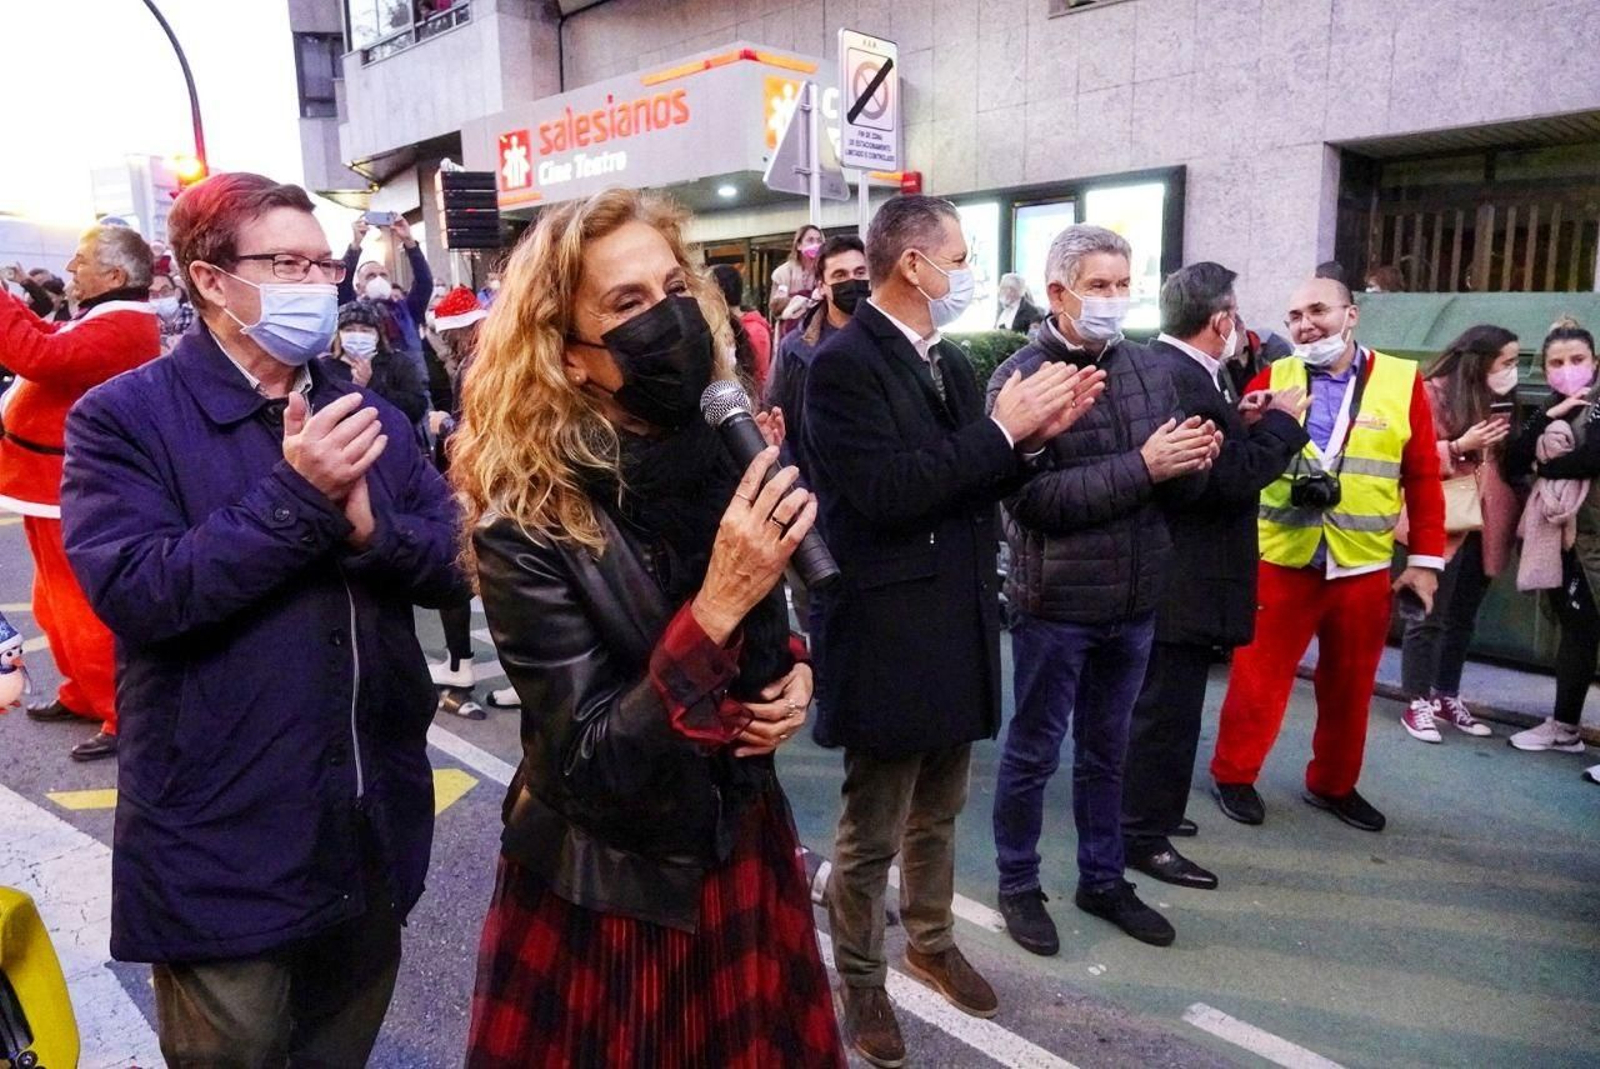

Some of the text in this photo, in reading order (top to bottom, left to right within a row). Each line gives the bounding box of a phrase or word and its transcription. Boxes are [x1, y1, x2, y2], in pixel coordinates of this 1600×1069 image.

[540, 88, 690, 155] salesianos
[538, 151, 627, 186] Cine Teatro
